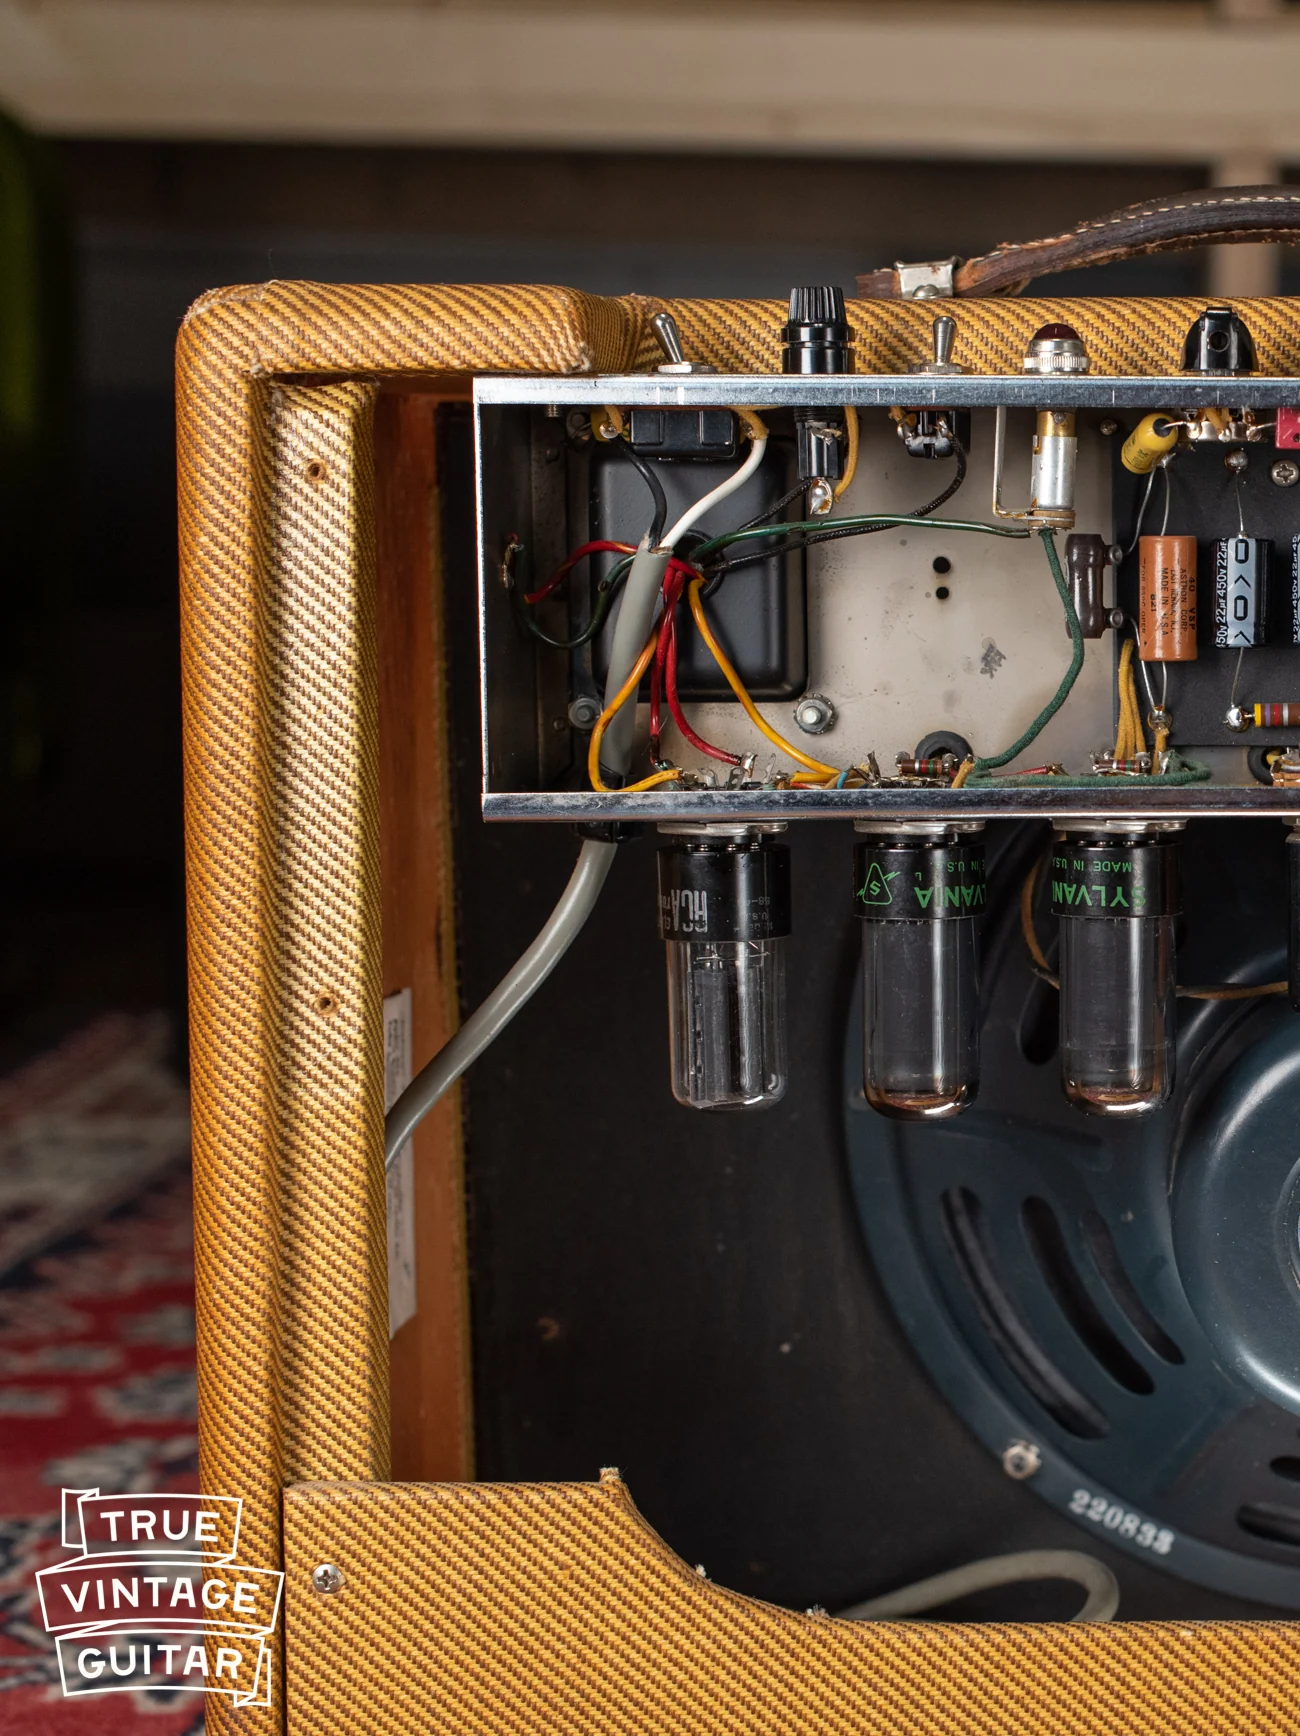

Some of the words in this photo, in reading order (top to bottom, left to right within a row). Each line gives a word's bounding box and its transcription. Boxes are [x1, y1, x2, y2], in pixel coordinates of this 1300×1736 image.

[1189, 576, 1195, 592] 40
[1162, 596, 1168, 605] IN
[1073, 860, 1084, 871] IN
[1093, 861, 1132, 872] MADE
[671, 889, 708, 933] RCA
